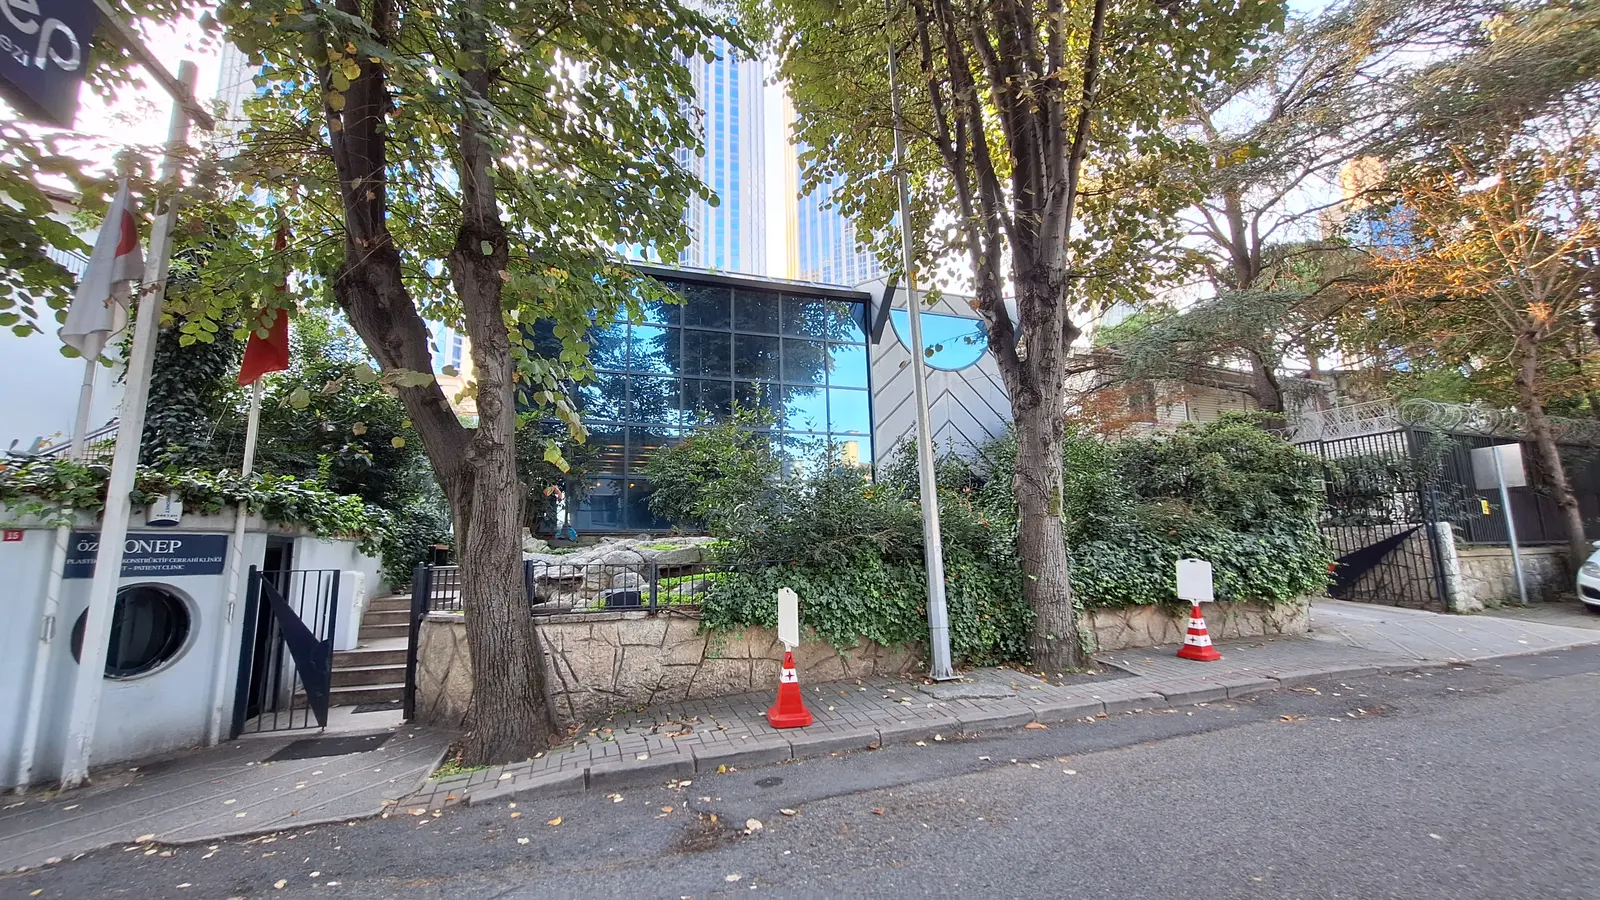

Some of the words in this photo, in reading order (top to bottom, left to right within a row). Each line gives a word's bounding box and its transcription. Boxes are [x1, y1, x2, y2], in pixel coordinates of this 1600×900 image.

[7, 531, 20, 540] 15
[77, 540, 99, 552] ÖZ
[123, 539, 182, 554] ONEP
[122, 556, 167, 564] KONSTRÜKTİF
